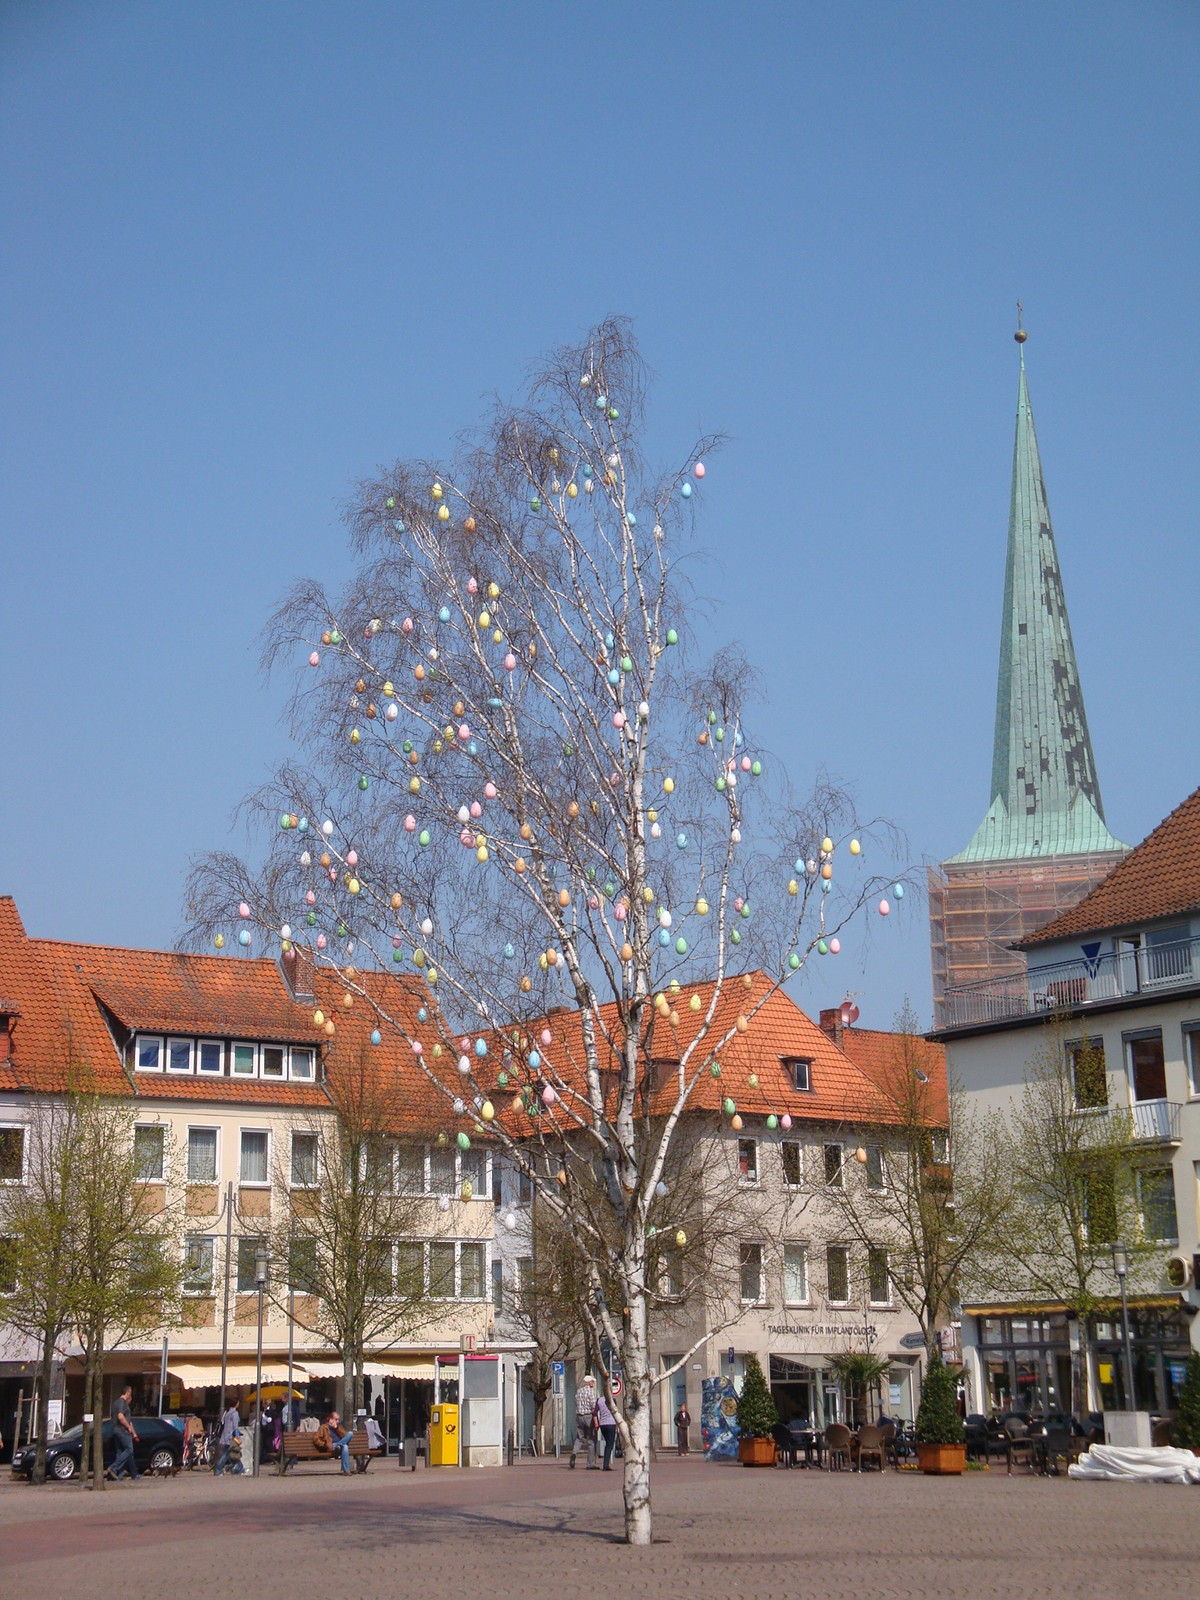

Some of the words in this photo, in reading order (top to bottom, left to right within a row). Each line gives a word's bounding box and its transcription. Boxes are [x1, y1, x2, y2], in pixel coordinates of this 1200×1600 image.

[768, 1325, 810, 1335] TAGESKLINIK
[811, 1324, 824, 1335] FÜR
[466, 1335, 475, 1349] T
[554, 1364, 562, 1372] P
